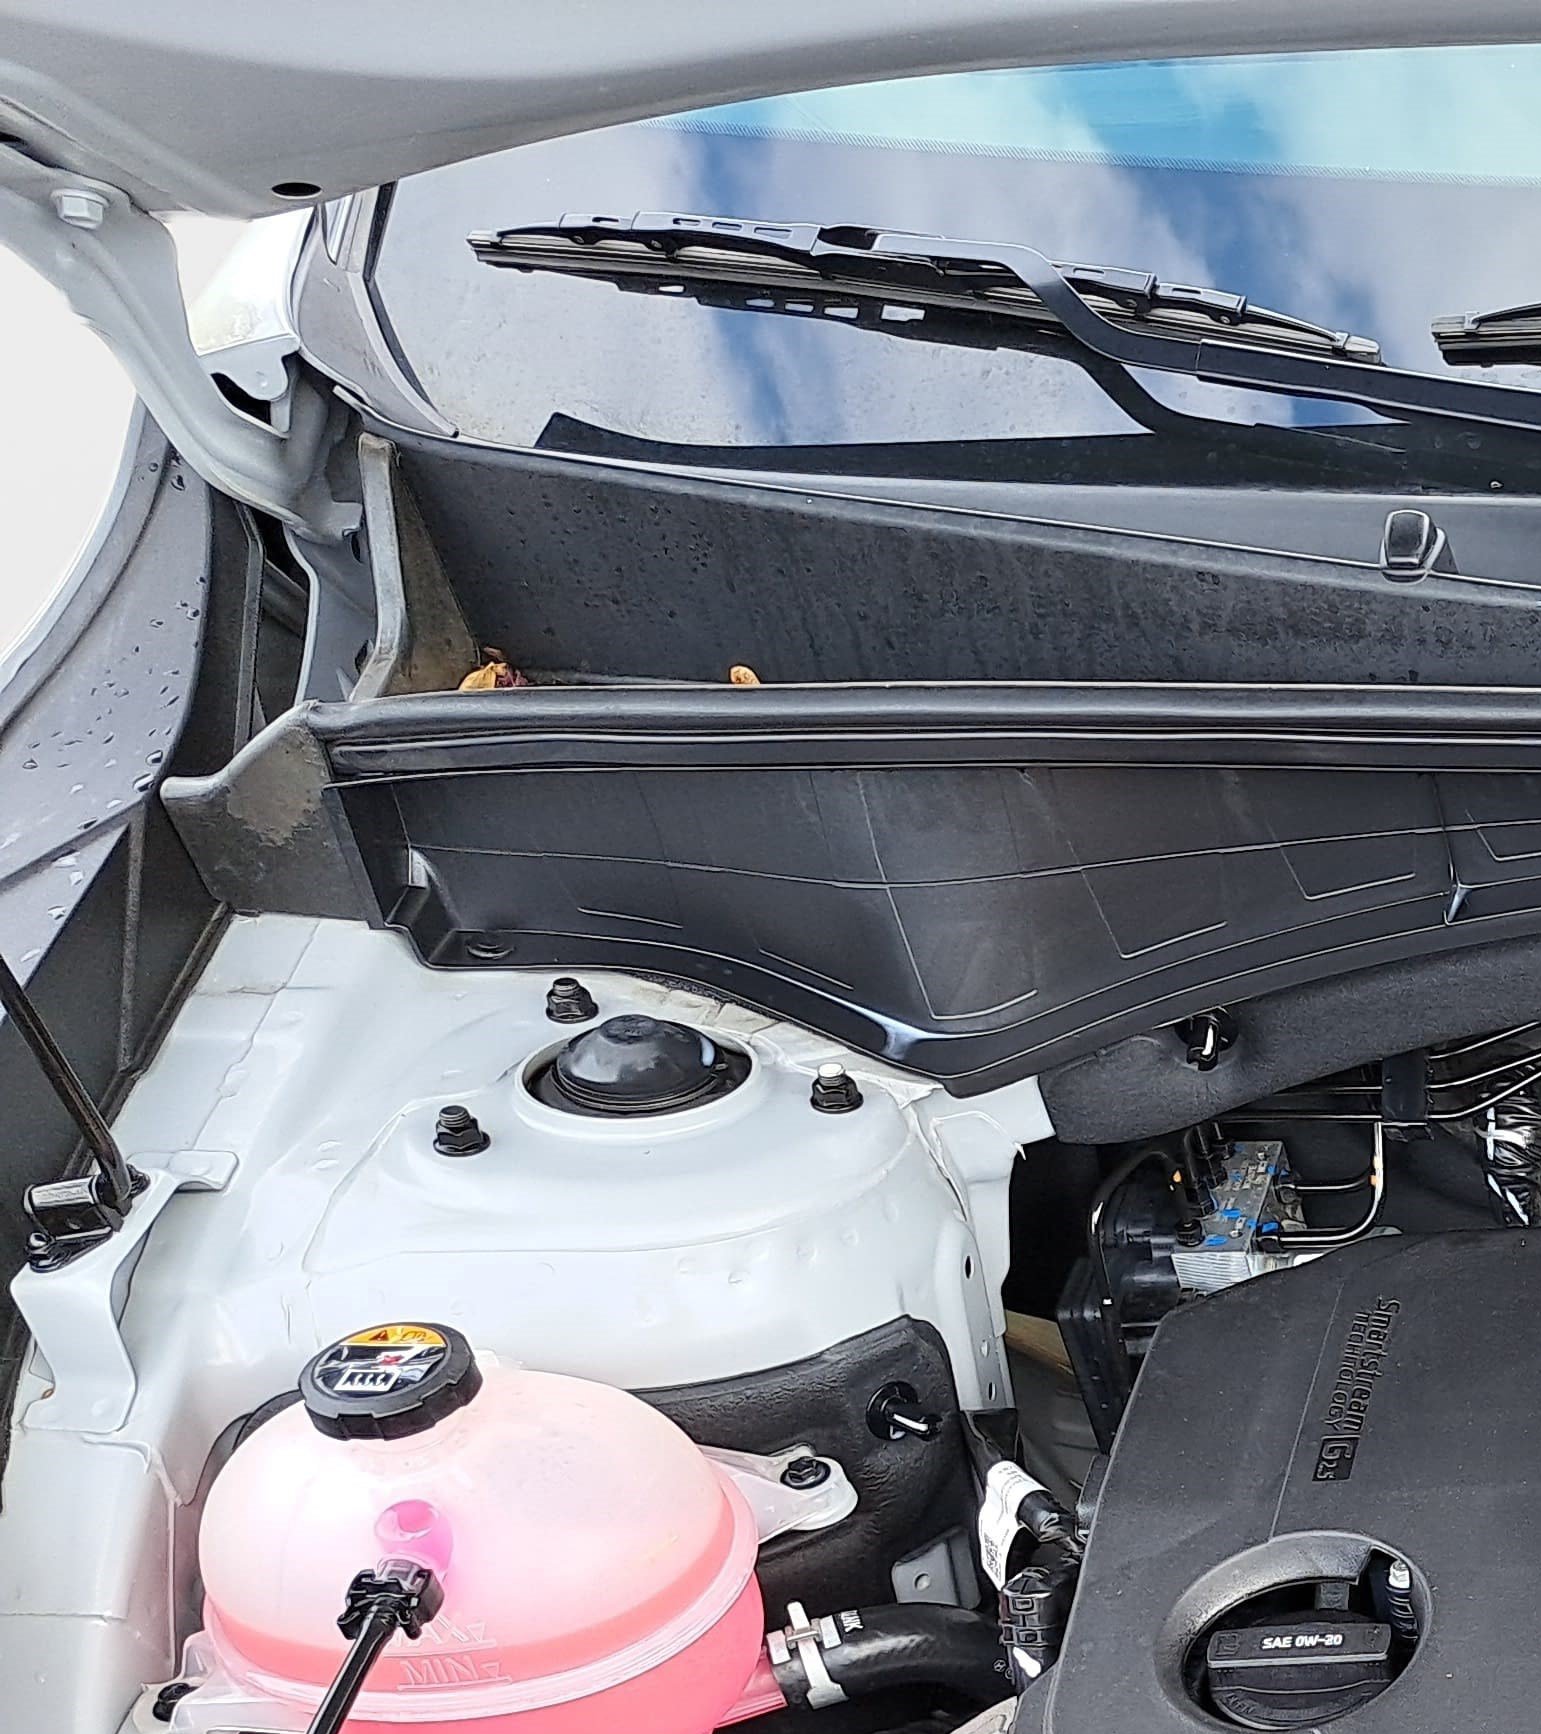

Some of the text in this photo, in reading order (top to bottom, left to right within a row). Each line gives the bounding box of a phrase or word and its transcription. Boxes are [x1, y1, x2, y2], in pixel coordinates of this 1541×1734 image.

[1323, 1311, 1371, 1431] TECHNOLOGY
[1344, 1294, 1403, 1433] Smartstream
[399, 1655, 480, 1686] MIN
[1261, 1632, 1343, 1650] SAE 0W-20
